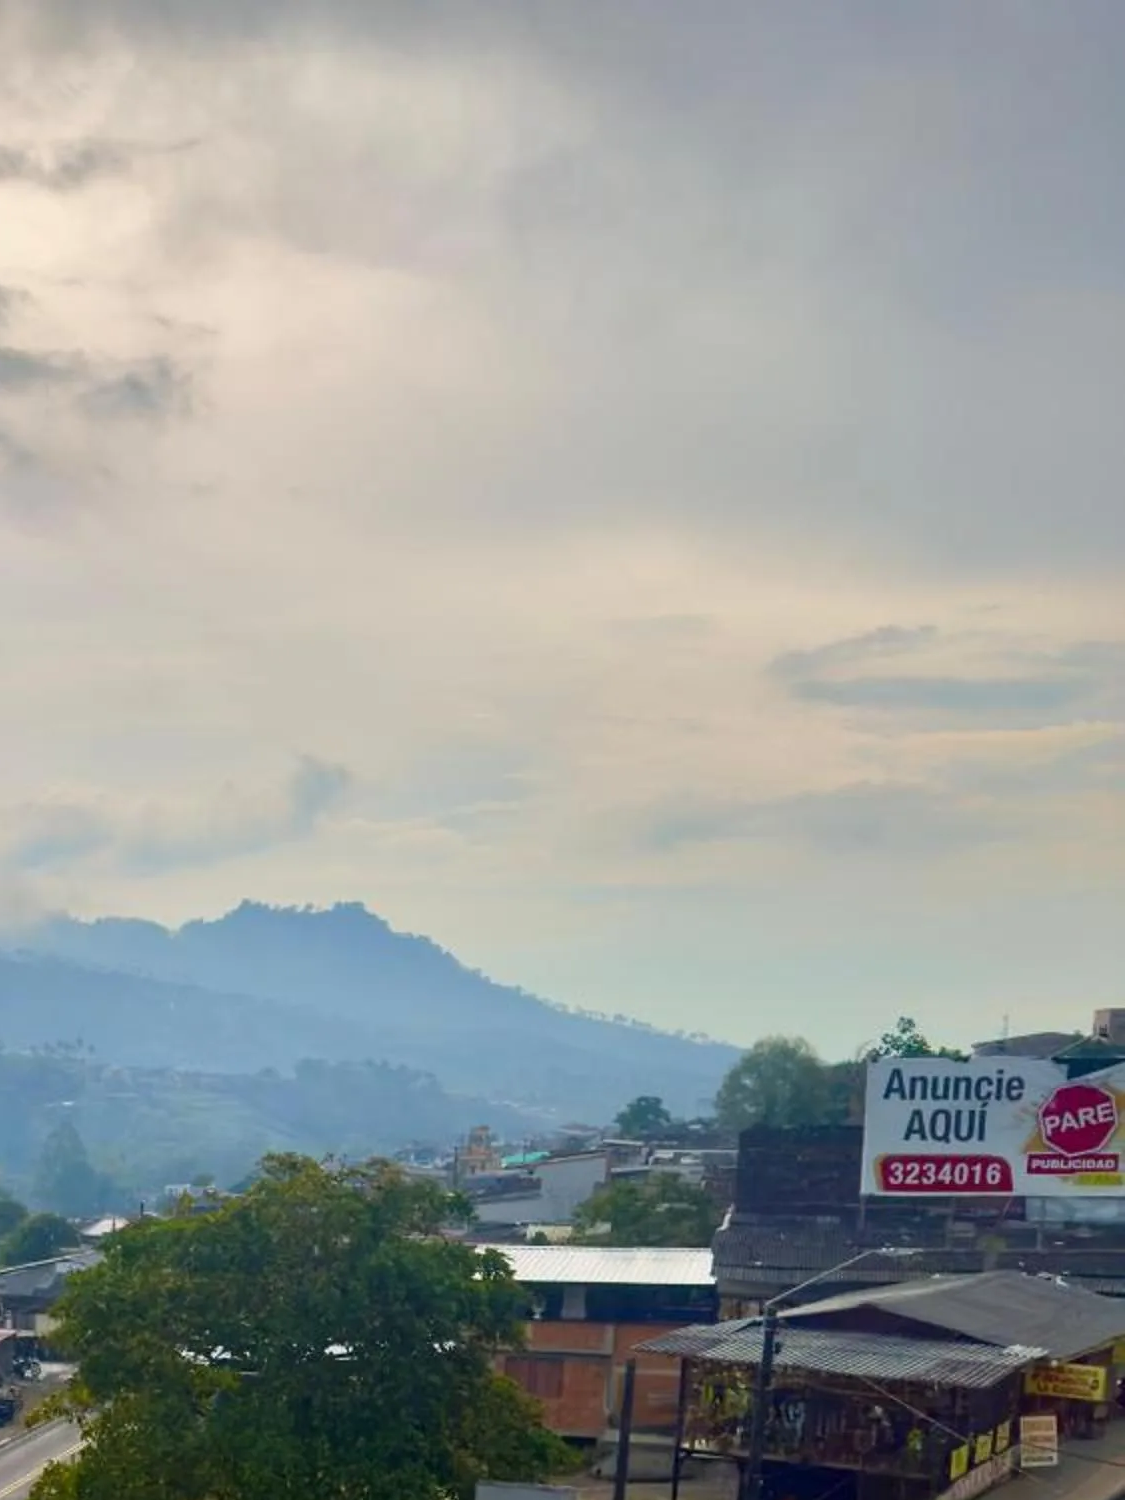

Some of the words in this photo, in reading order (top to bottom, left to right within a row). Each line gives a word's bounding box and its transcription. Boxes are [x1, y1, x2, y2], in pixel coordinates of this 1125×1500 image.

[883, 1068, 1025, 1101] Anuncie
[903, 1102, 988, 1143] AQUÍ
[1043, 1103, 1114, 1136] PARE
[889, 1162, 1001, 1185] 3234016
[1031, 1159, 1115, 1169] PUBLICIDAD
